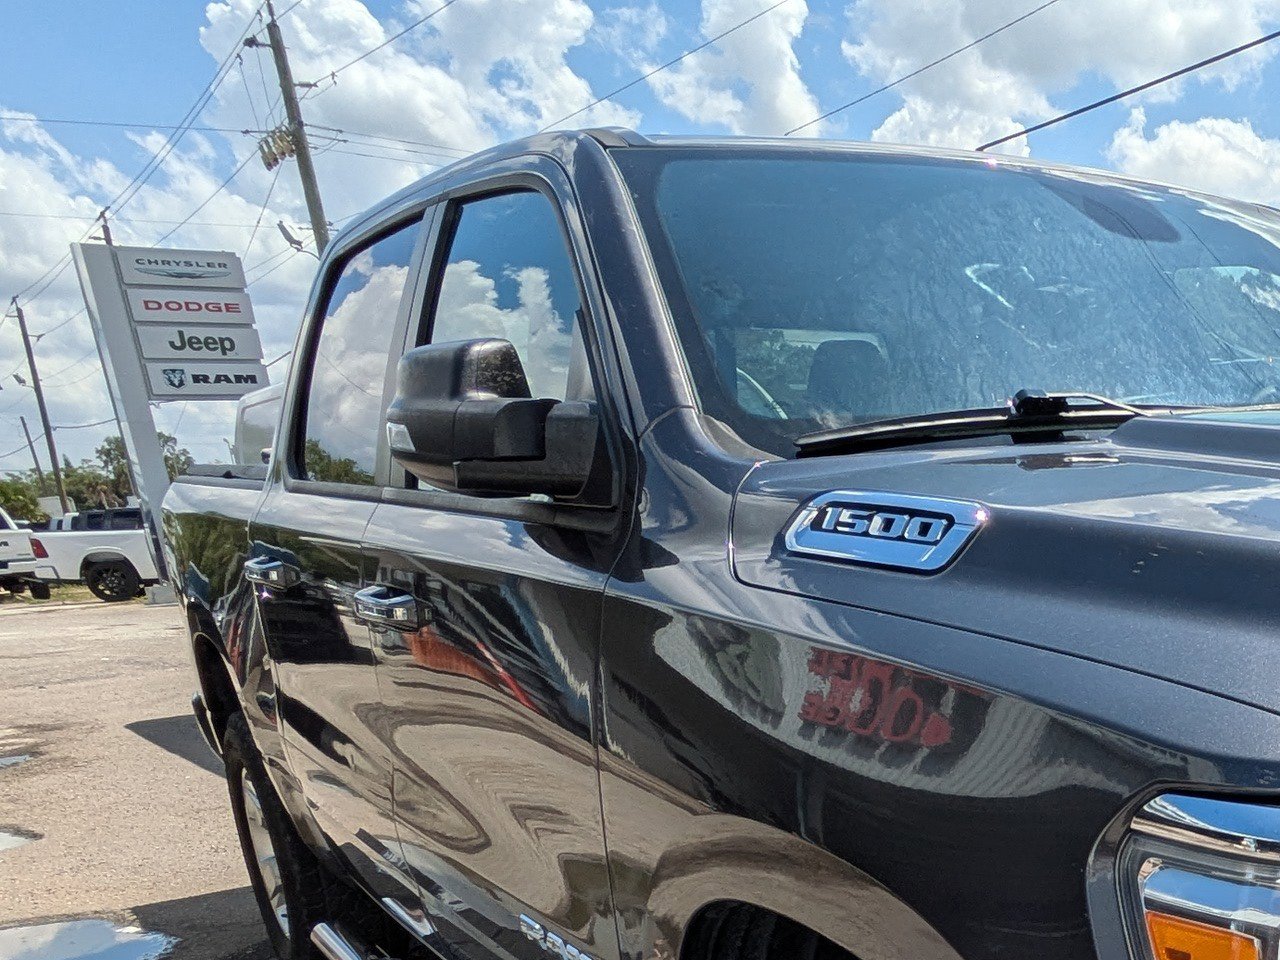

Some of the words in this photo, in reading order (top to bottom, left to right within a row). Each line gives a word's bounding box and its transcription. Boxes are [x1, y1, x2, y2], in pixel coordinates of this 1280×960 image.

[134, 258, 228, 269] CHRYSLER
[142, 299, 242, 314] DODGE
[169, 330, 236, 356] Jeep
[191, 373, 258, 385] RAM
[820, 506, 949, 542] 1500
